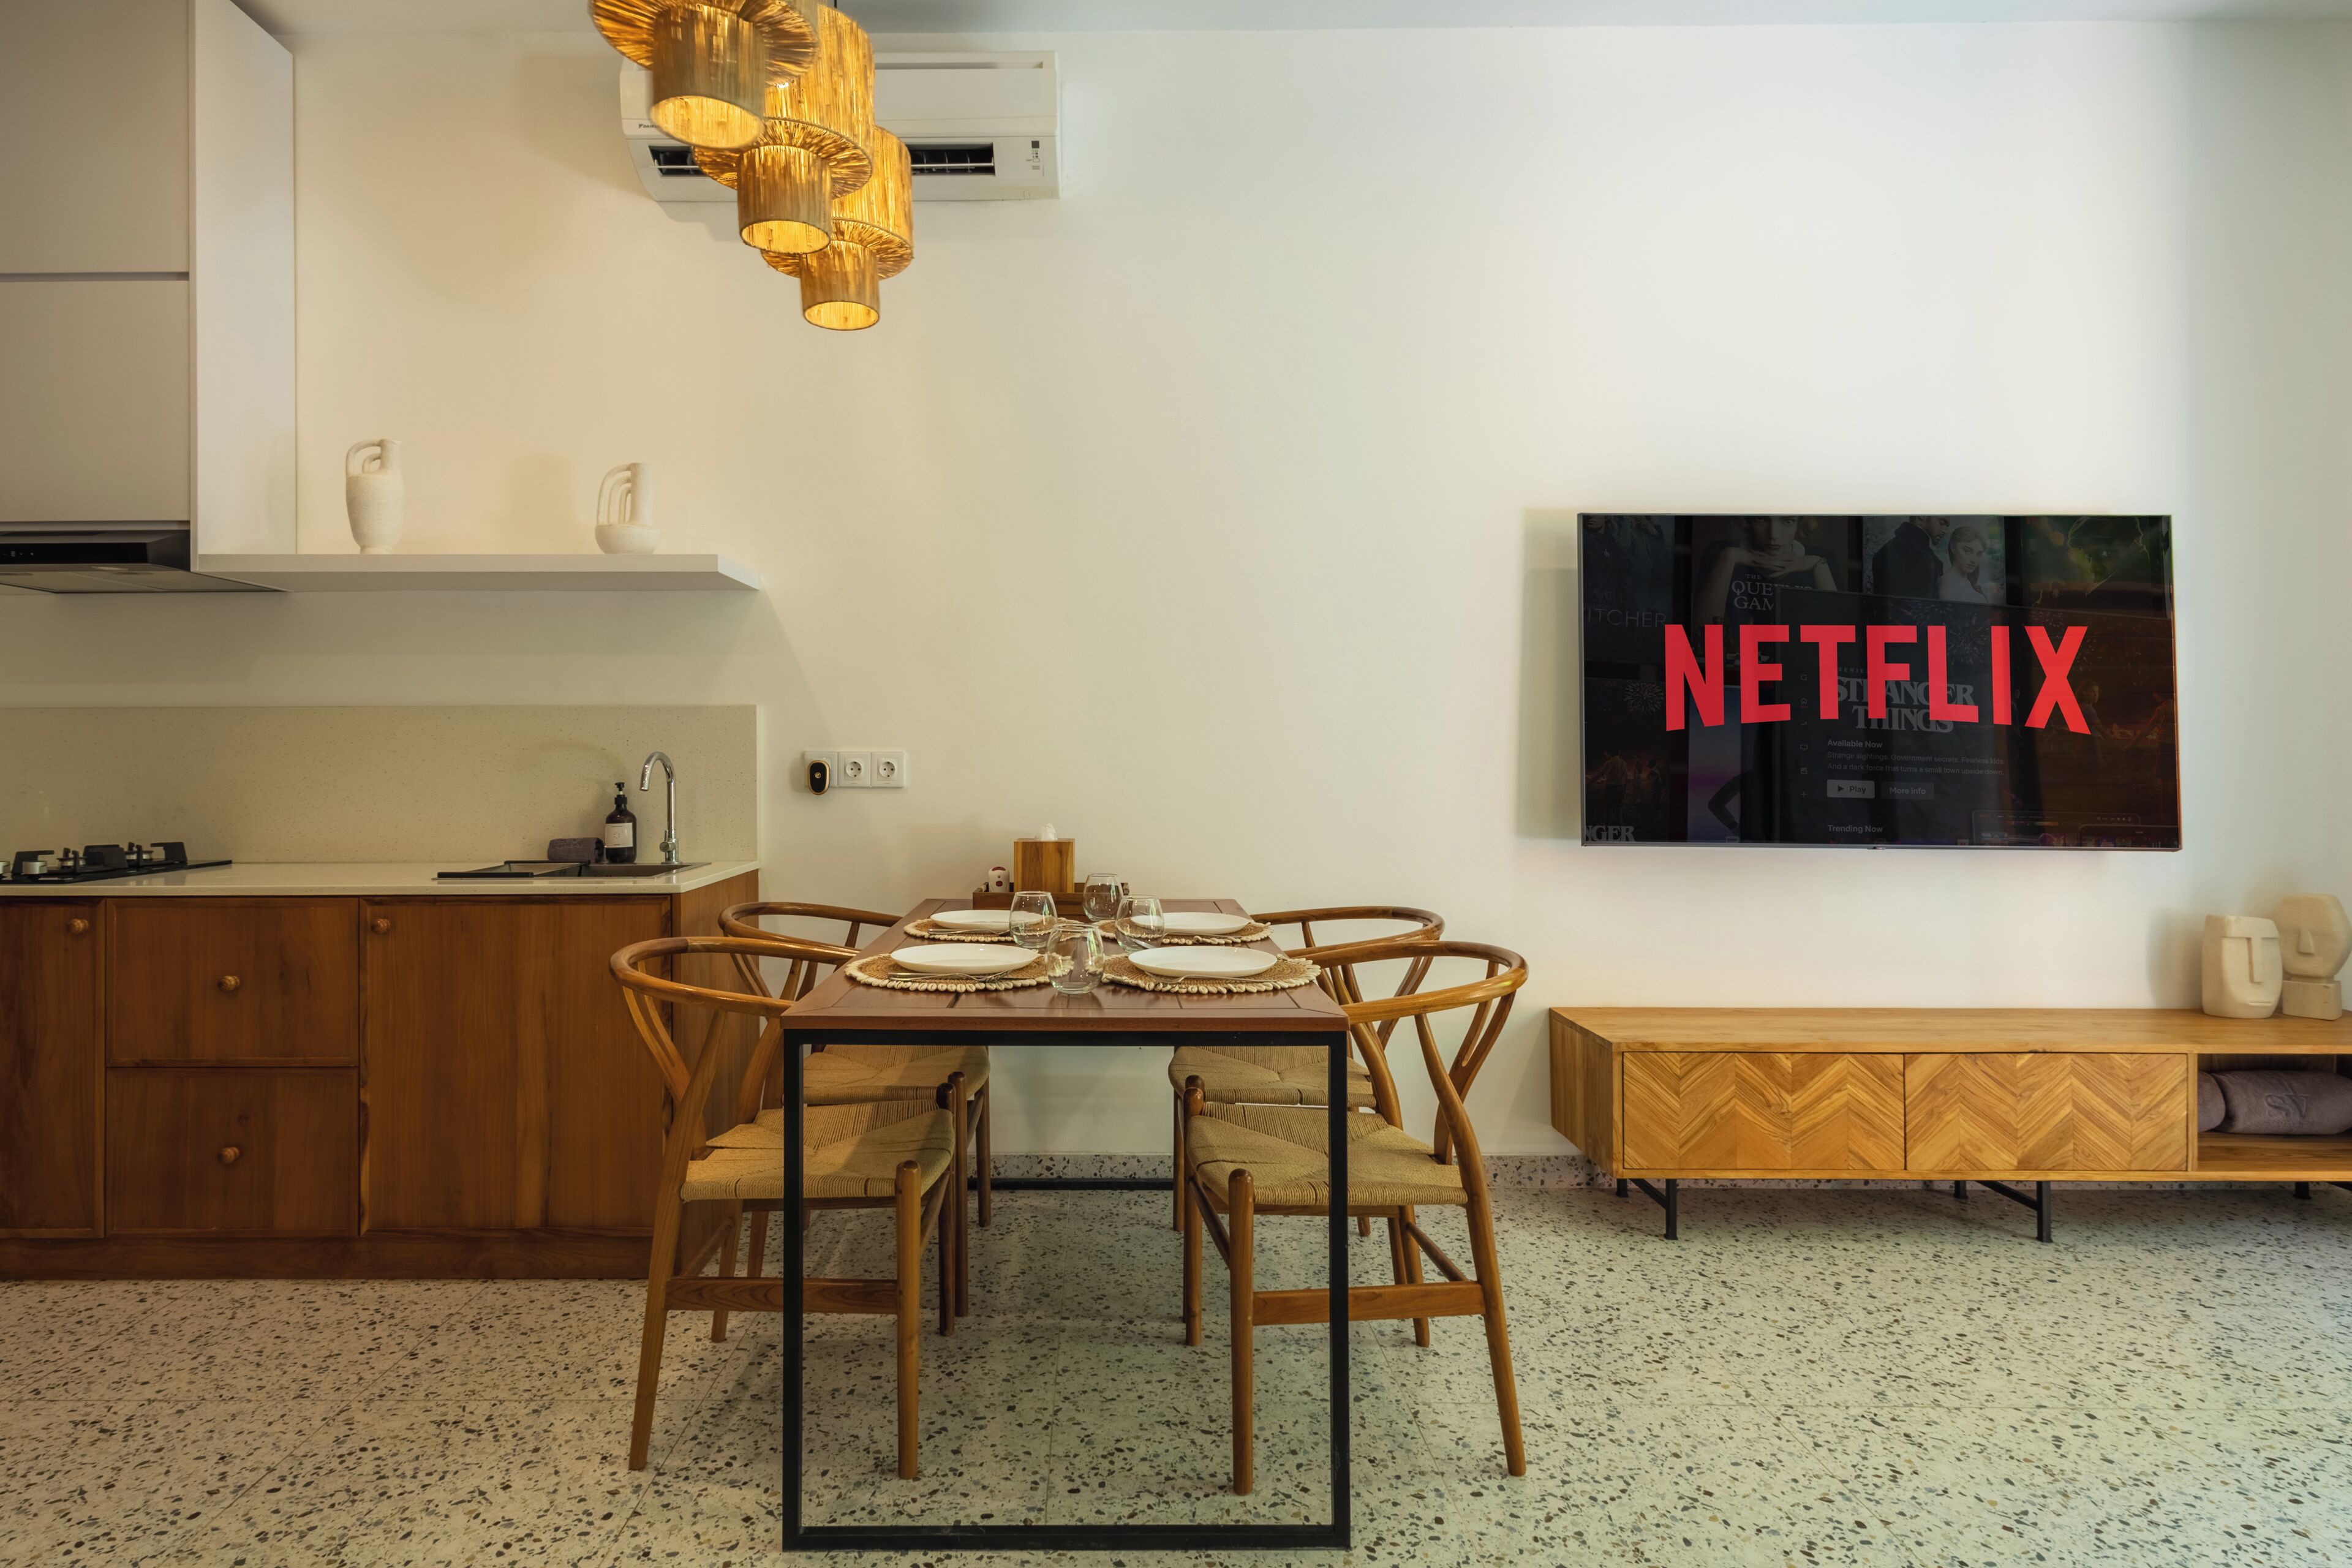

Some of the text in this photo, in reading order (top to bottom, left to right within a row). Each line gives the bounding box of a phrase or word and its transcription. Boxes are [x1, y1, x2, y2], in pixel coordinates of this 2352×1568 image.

[1585, 608, 1666, 627] ITCHER
[1665, 624, 2090, 734] NETFLIX
[1827, 752, 1855, 760] Strange
[1856, 753, 1890, 761] sightings.
[1850, 786, 1866, 794] Play
[1828, 824, 1863, 834] Trending
